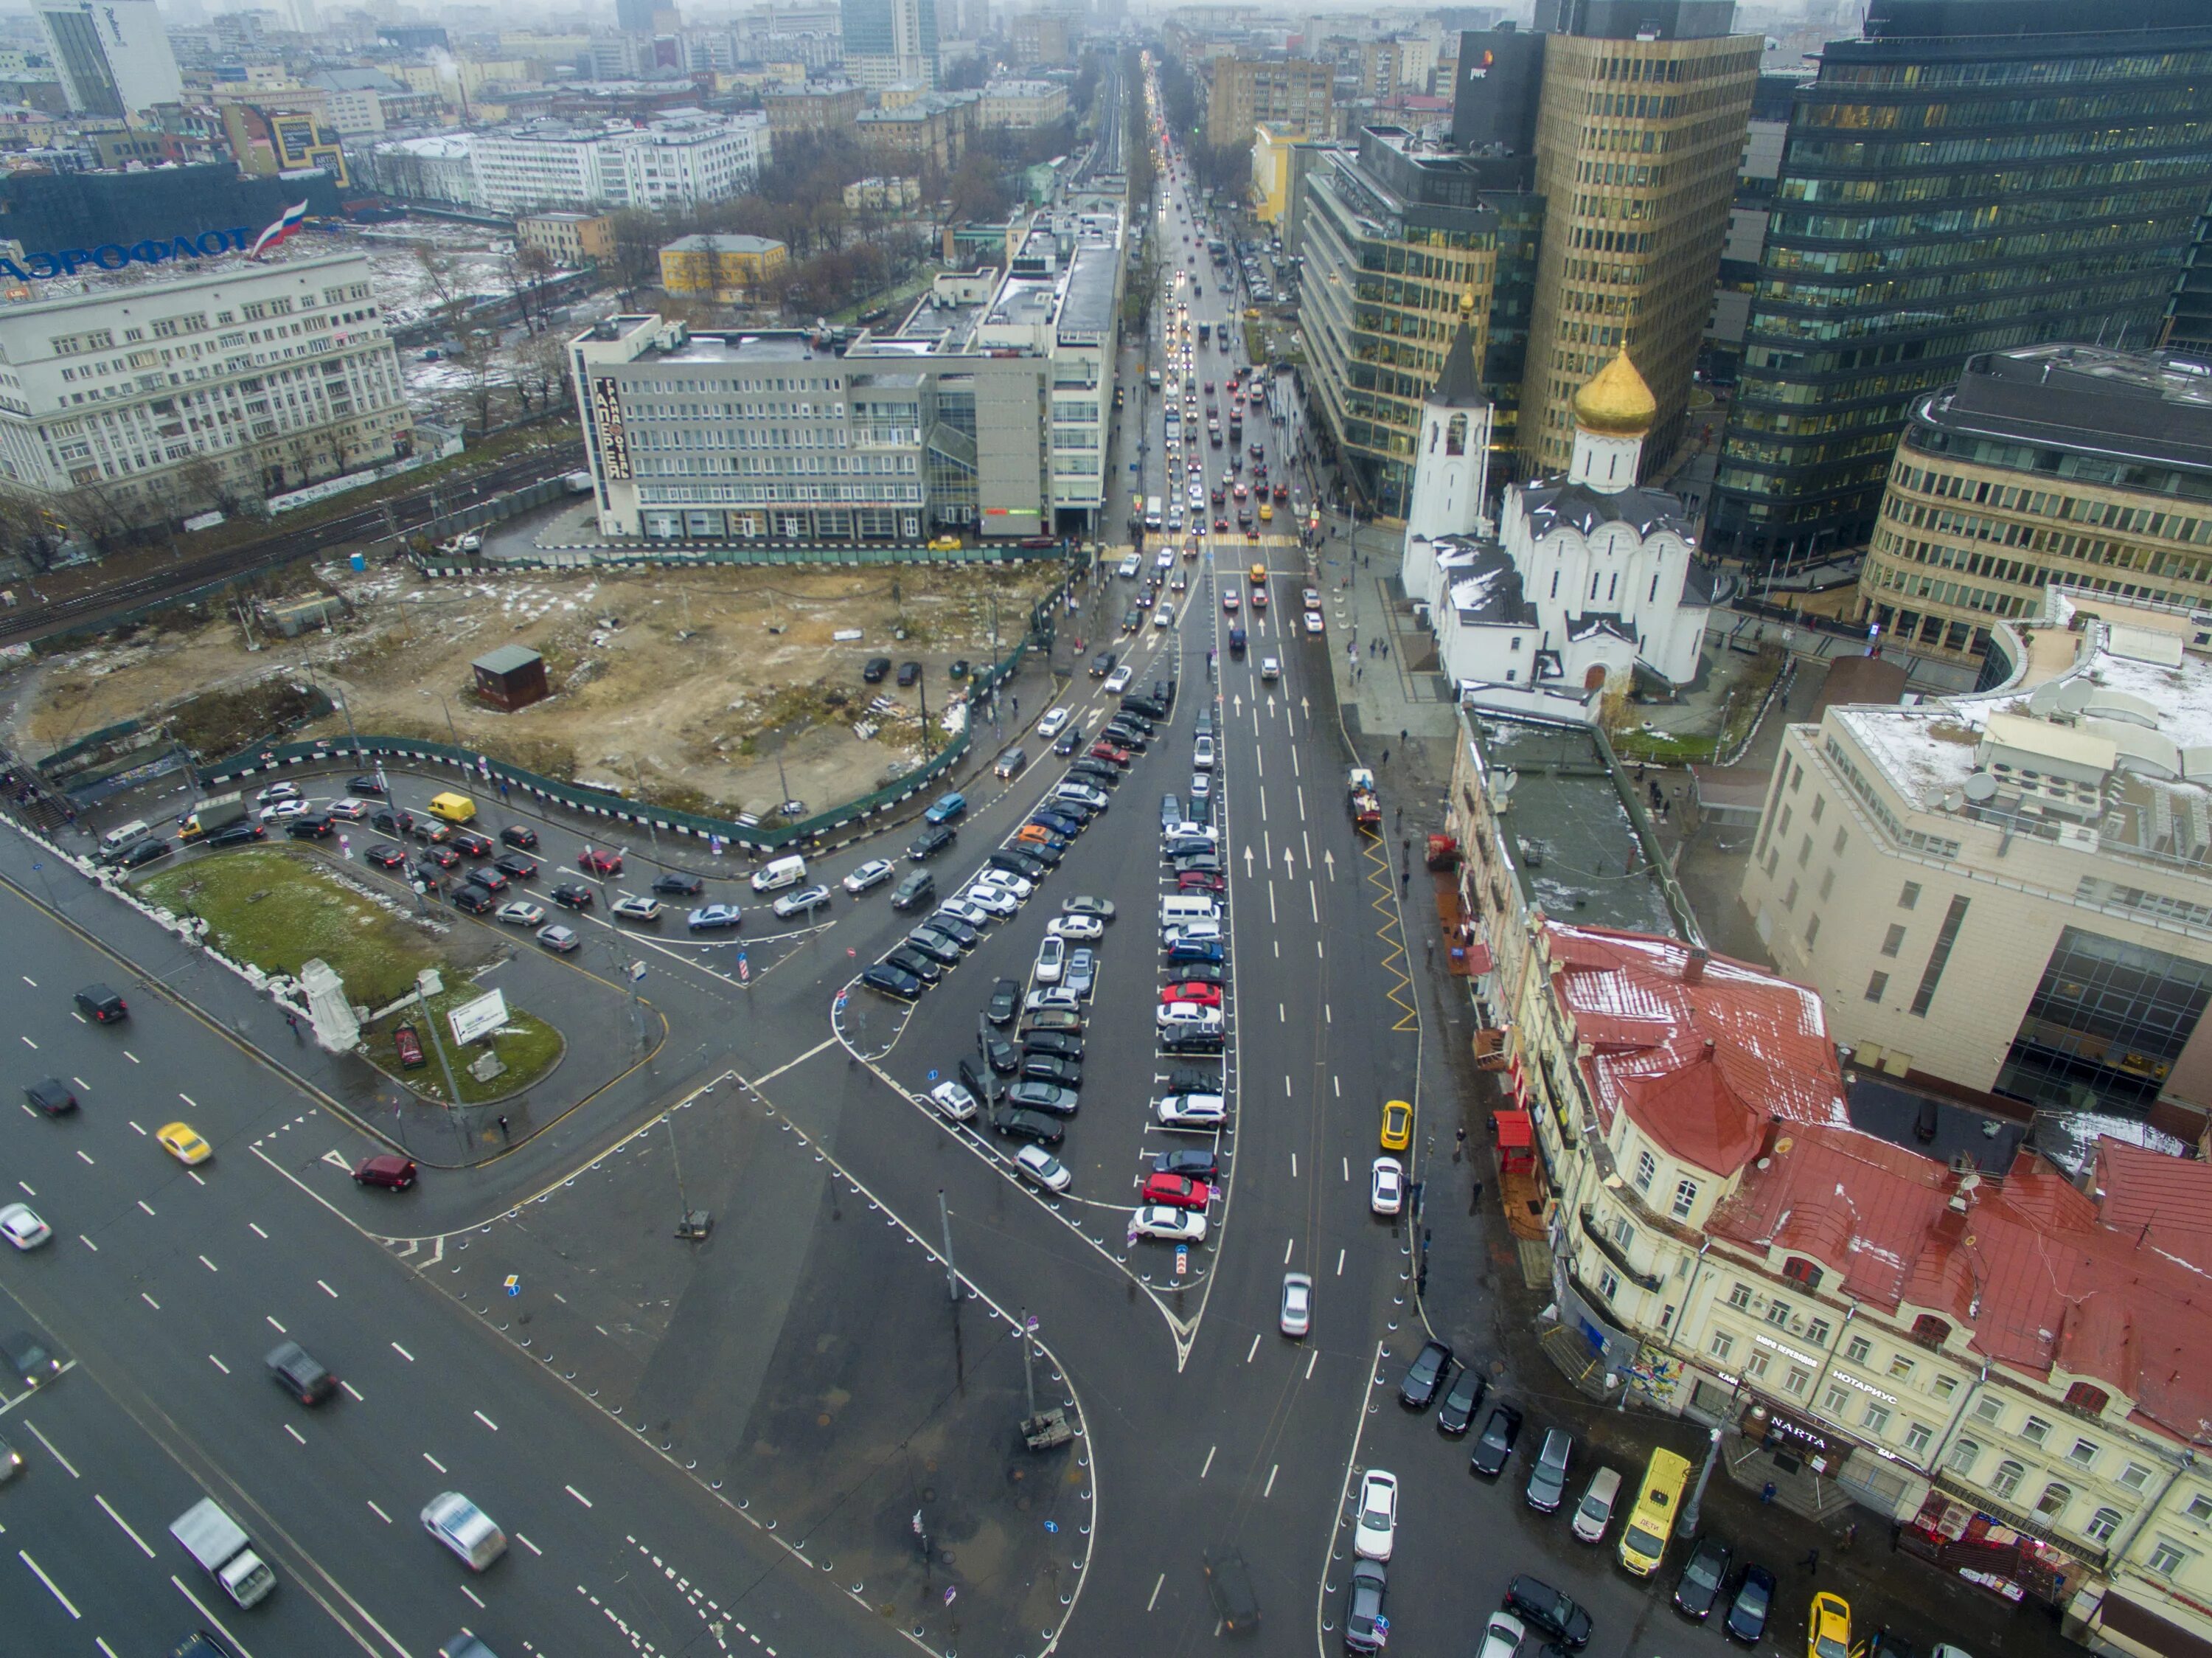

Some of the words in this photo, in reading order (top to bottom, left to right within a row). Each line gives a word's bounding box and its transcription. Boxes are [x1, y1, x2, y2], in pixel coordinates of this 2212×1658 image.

[0, 226, 249, 281] АЭРОФЛОТ
[593, 378, 620, 479] ГАЛЕРЕЯ
[605, 378, 621, 425] ГРАНД
[614, 435, 630, 479] ОТЕЛЬ
[1756, 1334, 1777, 1350] БЮРО
[1777, 1344, 1818, 1367] ПЕРЕВОДОВ
[1833, 1370, 1898, 1405] НОТАРИУС
[1771, 1416, 1826, 1449] NARTA
[1878, 1447, 1896, 1460] БАР
[1640, 1519, 1659, 1531] ДЕТИ
